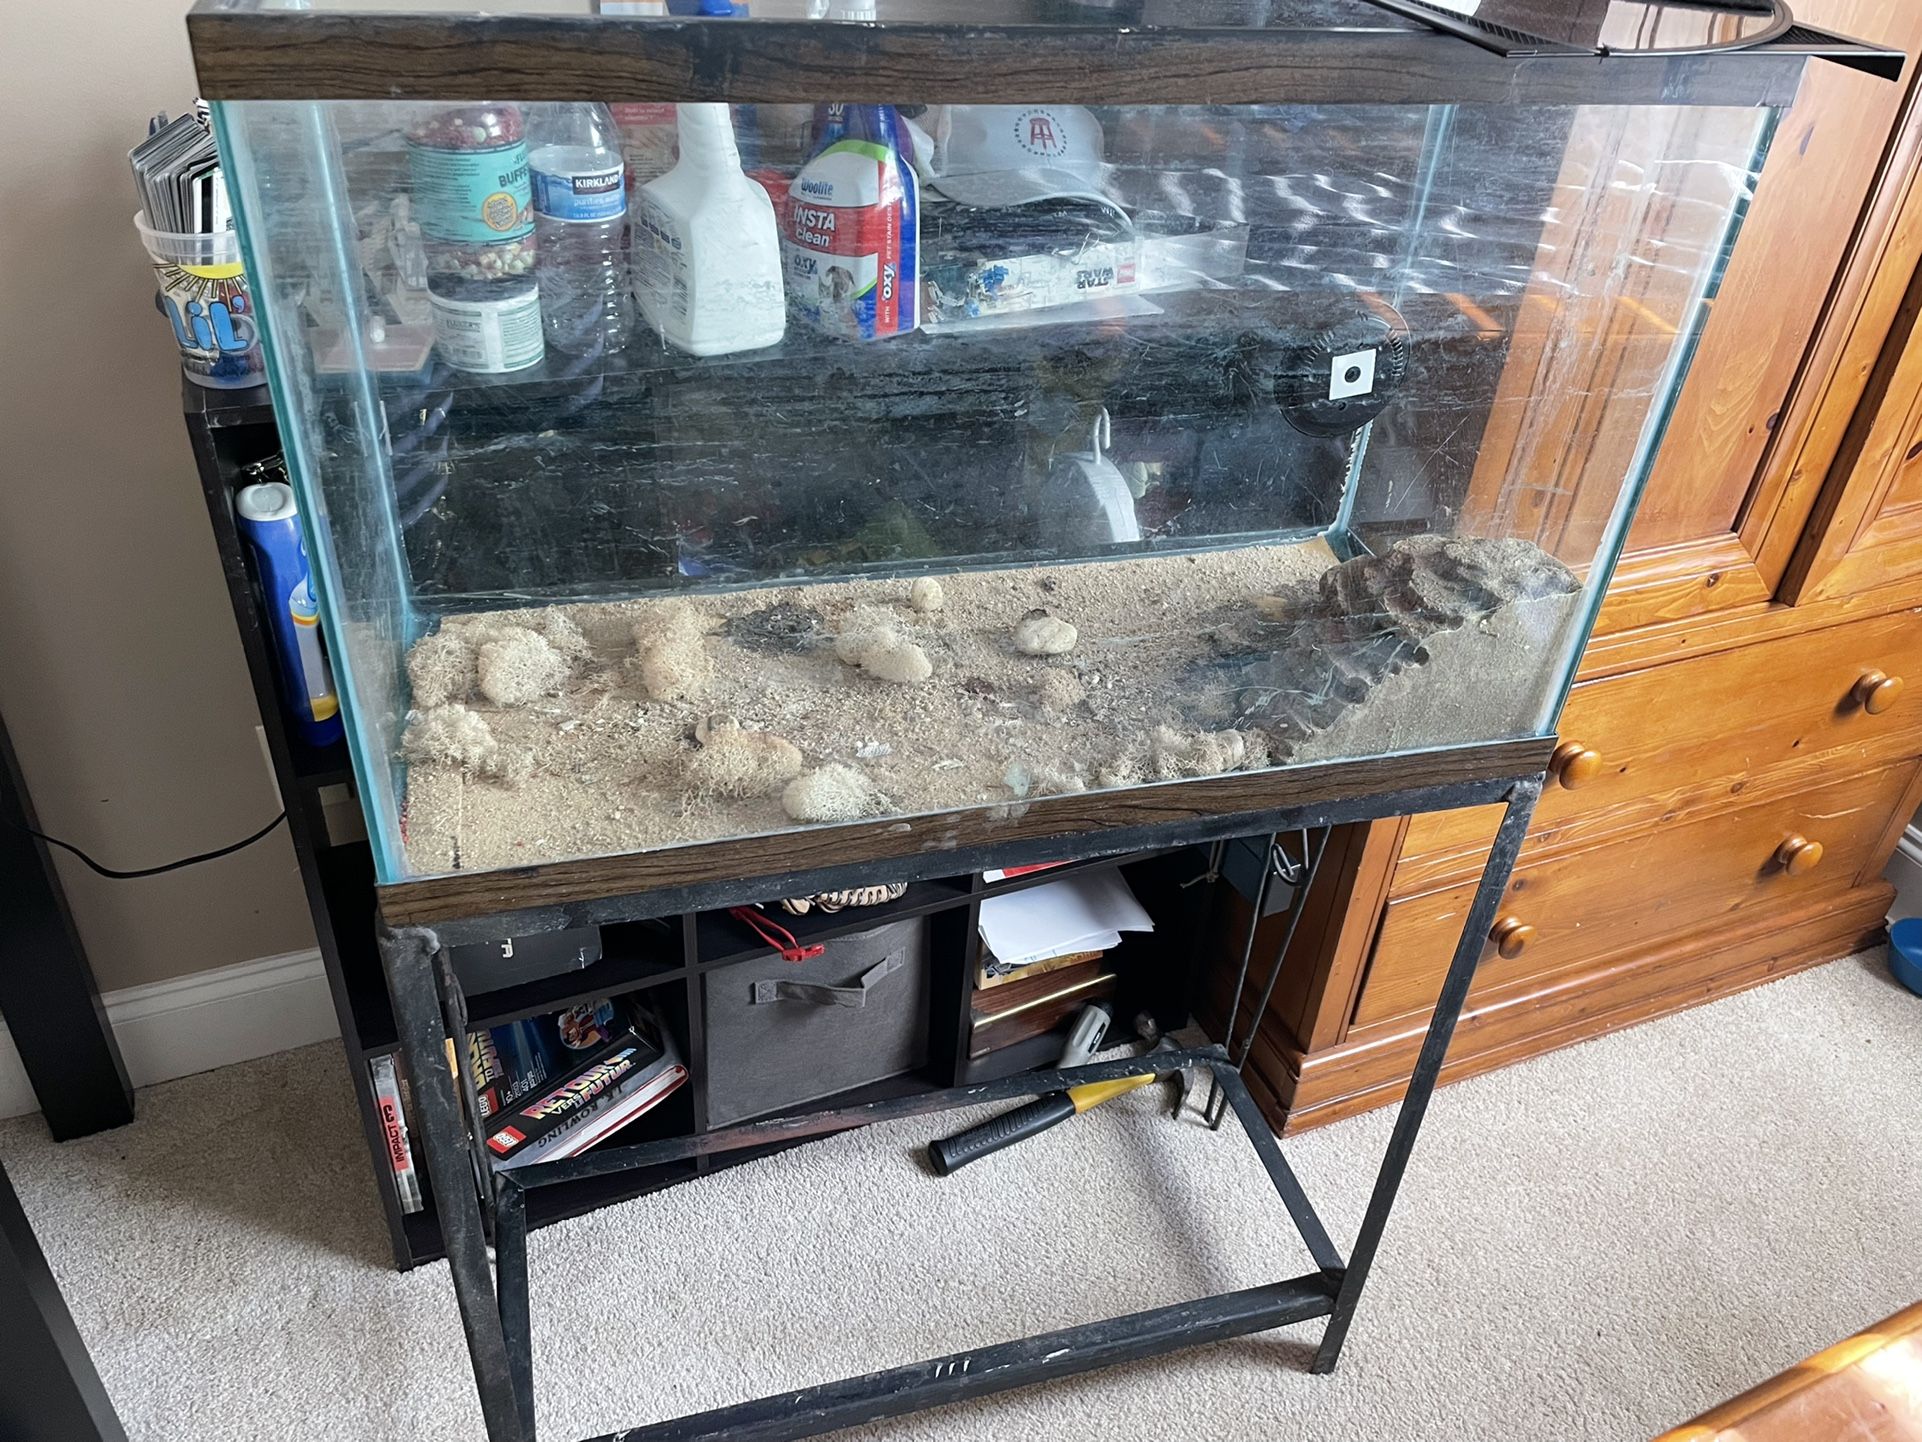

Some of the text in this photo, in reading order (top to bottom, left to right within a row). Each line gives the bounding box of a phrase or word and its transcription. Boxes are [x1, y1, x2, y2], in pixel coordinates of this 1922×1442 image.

[575, 174, 619, 189] KIRKLAND
[801, 177, 834, 197] Woolite
[794, 204, 836, 231] INSTA
[795, 227, 831, 248] clean
[520, 1057, 618, 1119] RETOUR
[581, 1059, 631, 1103] FUTUR
[478, 1095, 491, 1117] LEGO
[538, 1102, 599, 1148] ROWLING
[387, 1124, 406, 1163] IMPACT
